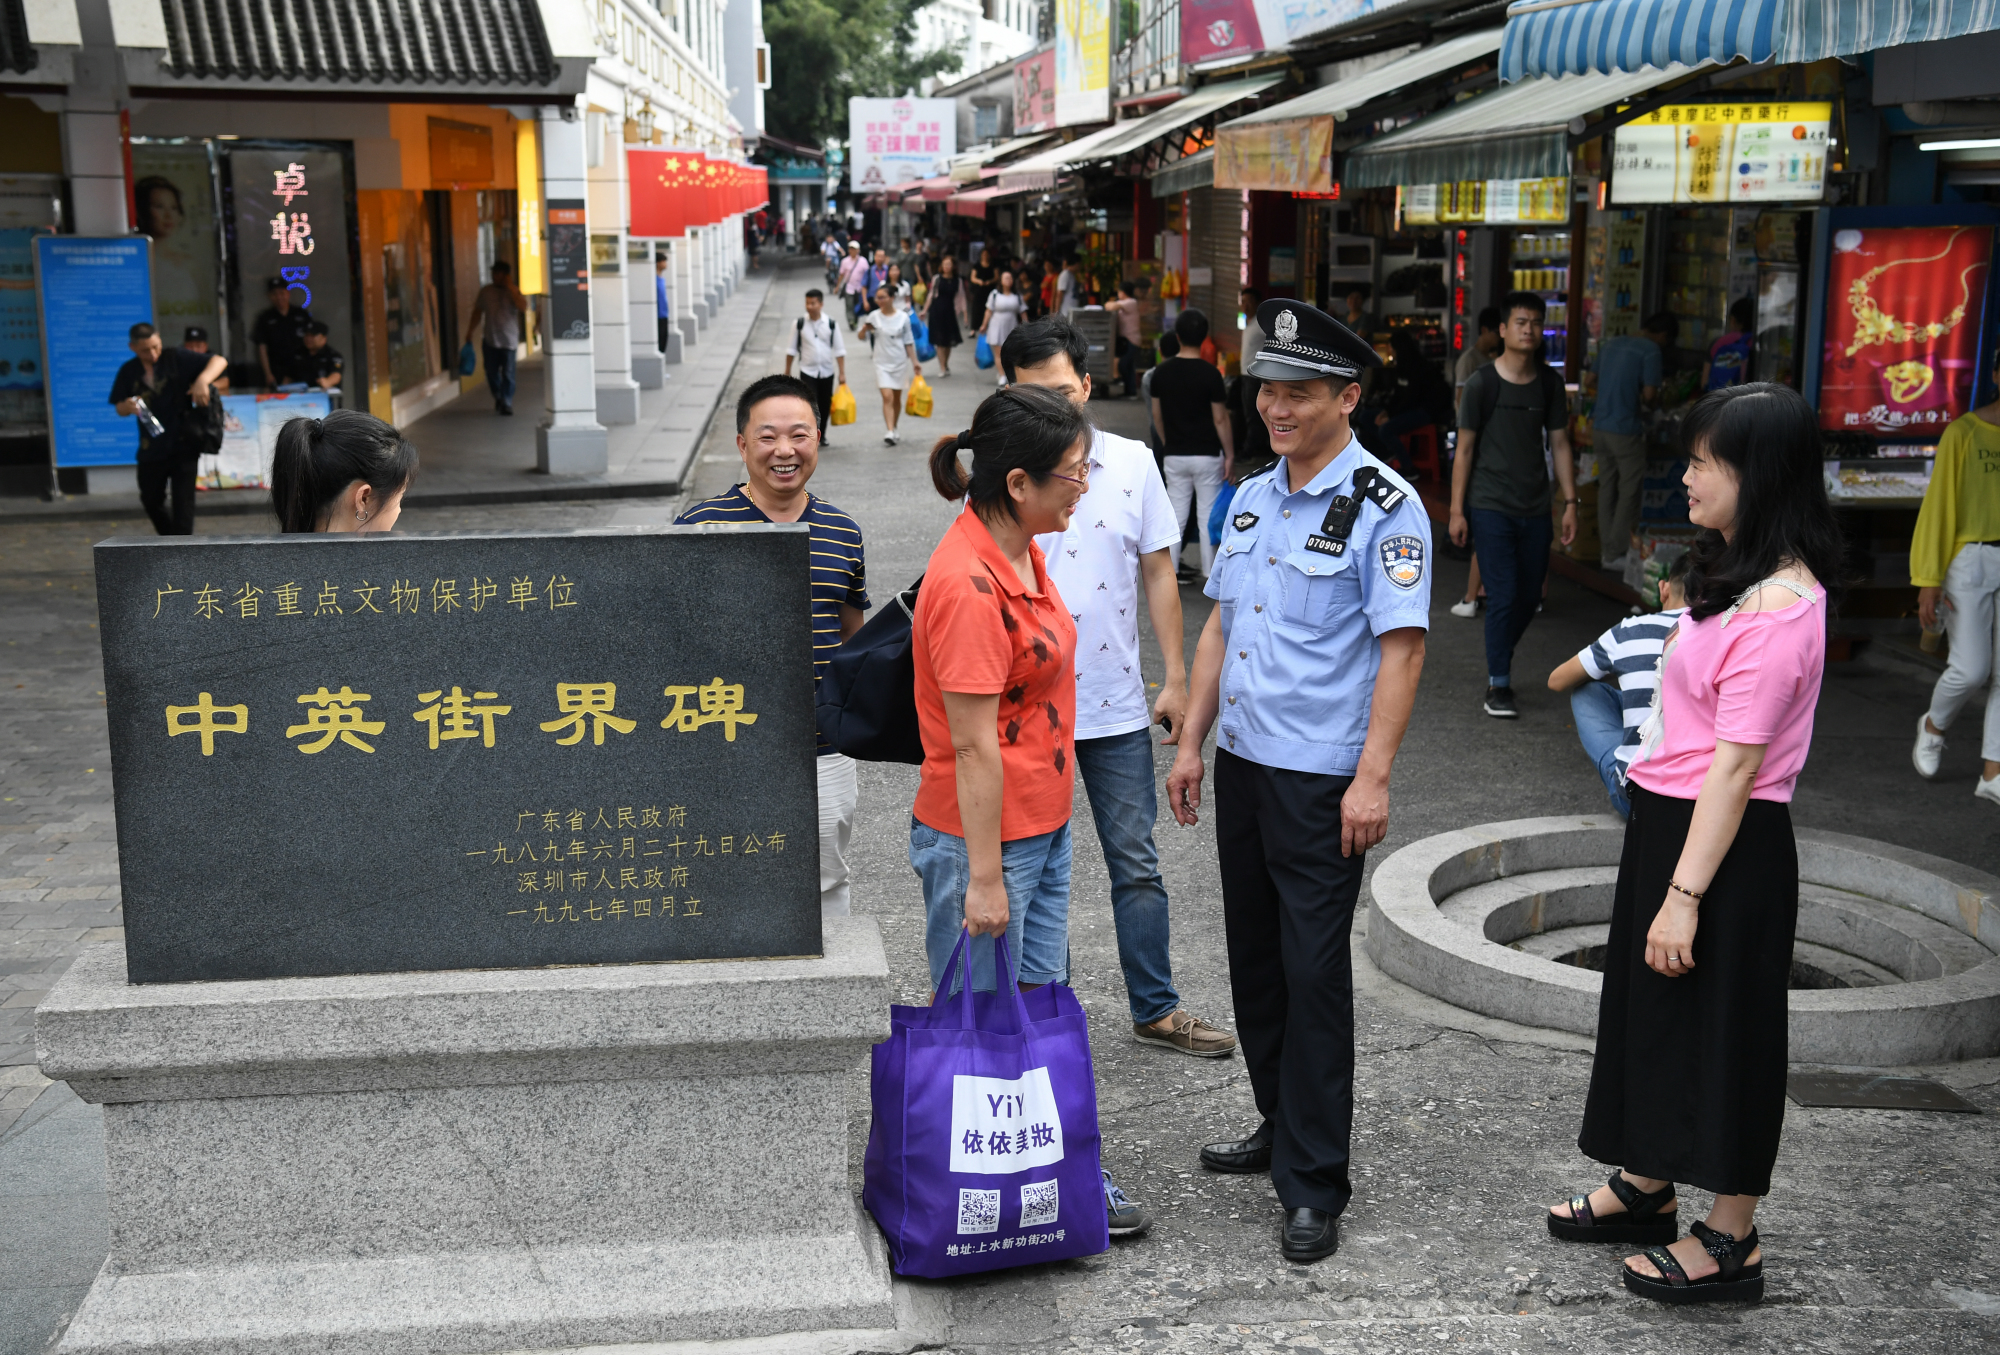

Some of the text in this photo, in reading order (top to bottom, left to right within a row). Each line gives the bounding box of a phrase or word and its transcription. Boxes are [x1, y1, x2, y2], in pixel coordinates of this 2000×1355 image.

[1307, 536, 1343, 553] 070909
[153, 575, 577, 619] 广东省重点文物保护单位
[165, 677, 758, 756] 中英街界碑
[515, 804, 688, 833] 广东省人民政府
[466, 831, 787, 865] 一九八九年六月二十九日公布
[517, 866, 690, 893] 深圳市人民政府
[507, 896, 703, 925] 一九九七年四月立
[946, 1229, 1066, 1257] 地址:上水新功街20号
